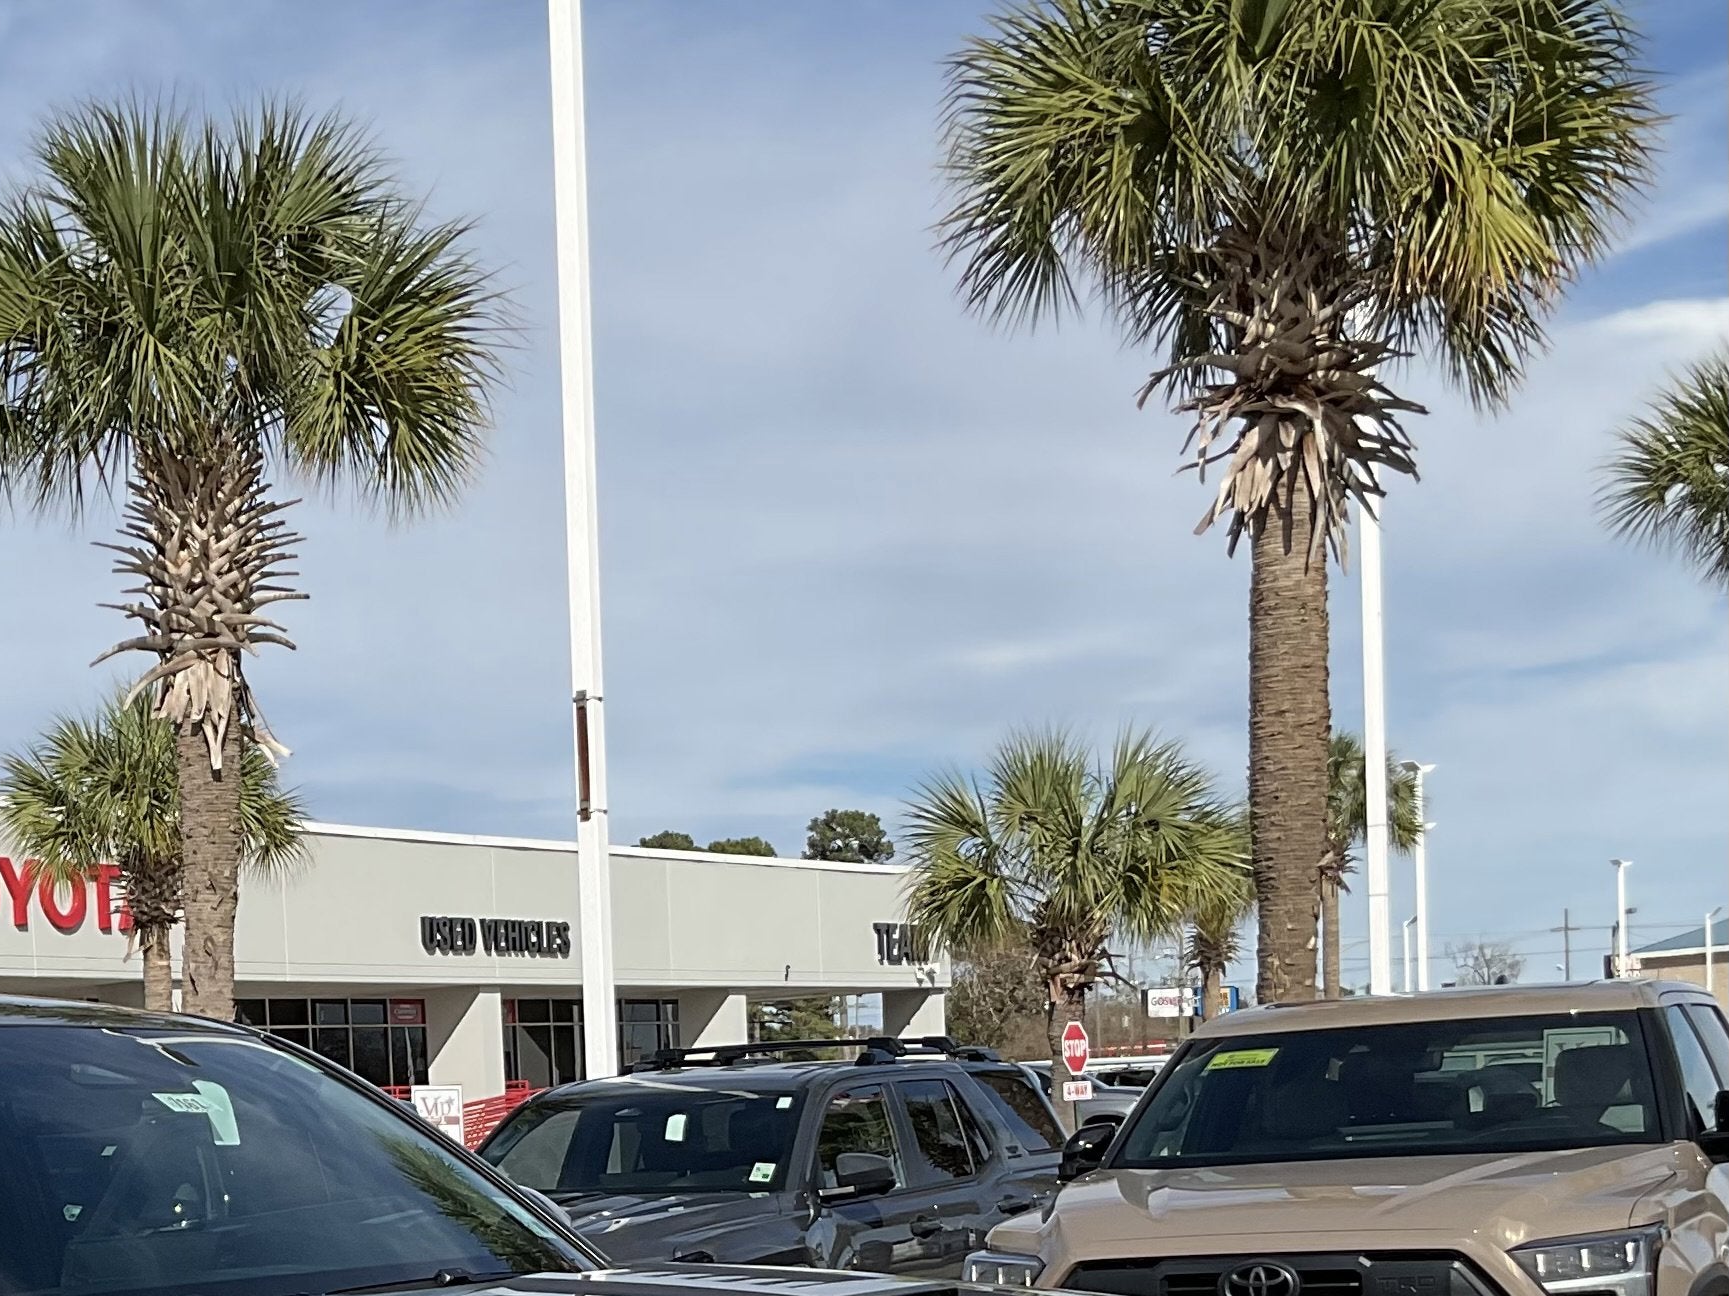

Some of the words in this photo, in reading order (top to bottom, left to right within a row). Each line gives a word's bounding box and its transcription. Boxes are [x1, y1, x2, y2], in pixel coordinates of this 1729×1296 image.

[420, 916, 477, 956] USED
[479, 918, 571, 959] VEHICLES
[1064, 1039, 1087, 1057] STOP
[1067, 1084, 1088, 1096] 4-WAY
